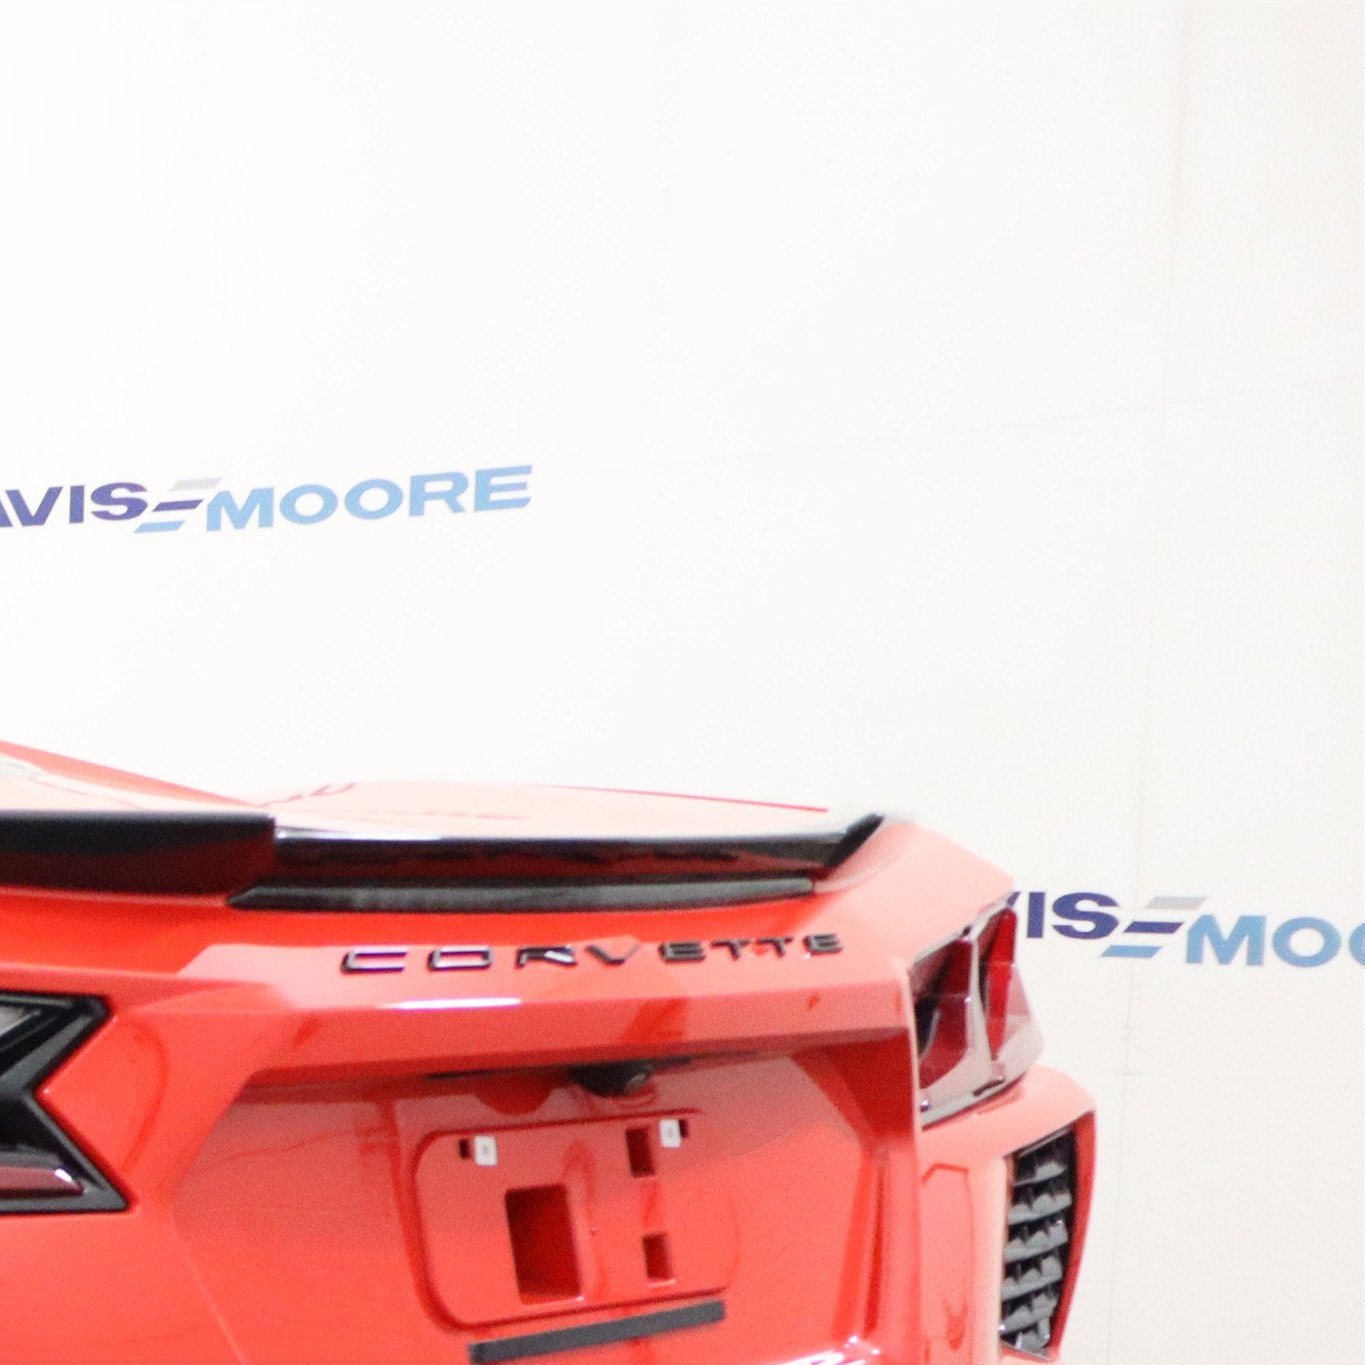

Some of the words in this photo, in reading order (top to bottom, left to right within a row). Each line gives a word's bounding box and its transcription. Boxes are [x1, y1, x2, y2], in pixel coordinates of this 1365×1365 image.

[206, 464, 533, 532] MOORE
[340, 932, 844, 974] CORVETTE
[1185, 913, 1365, 968] MO
